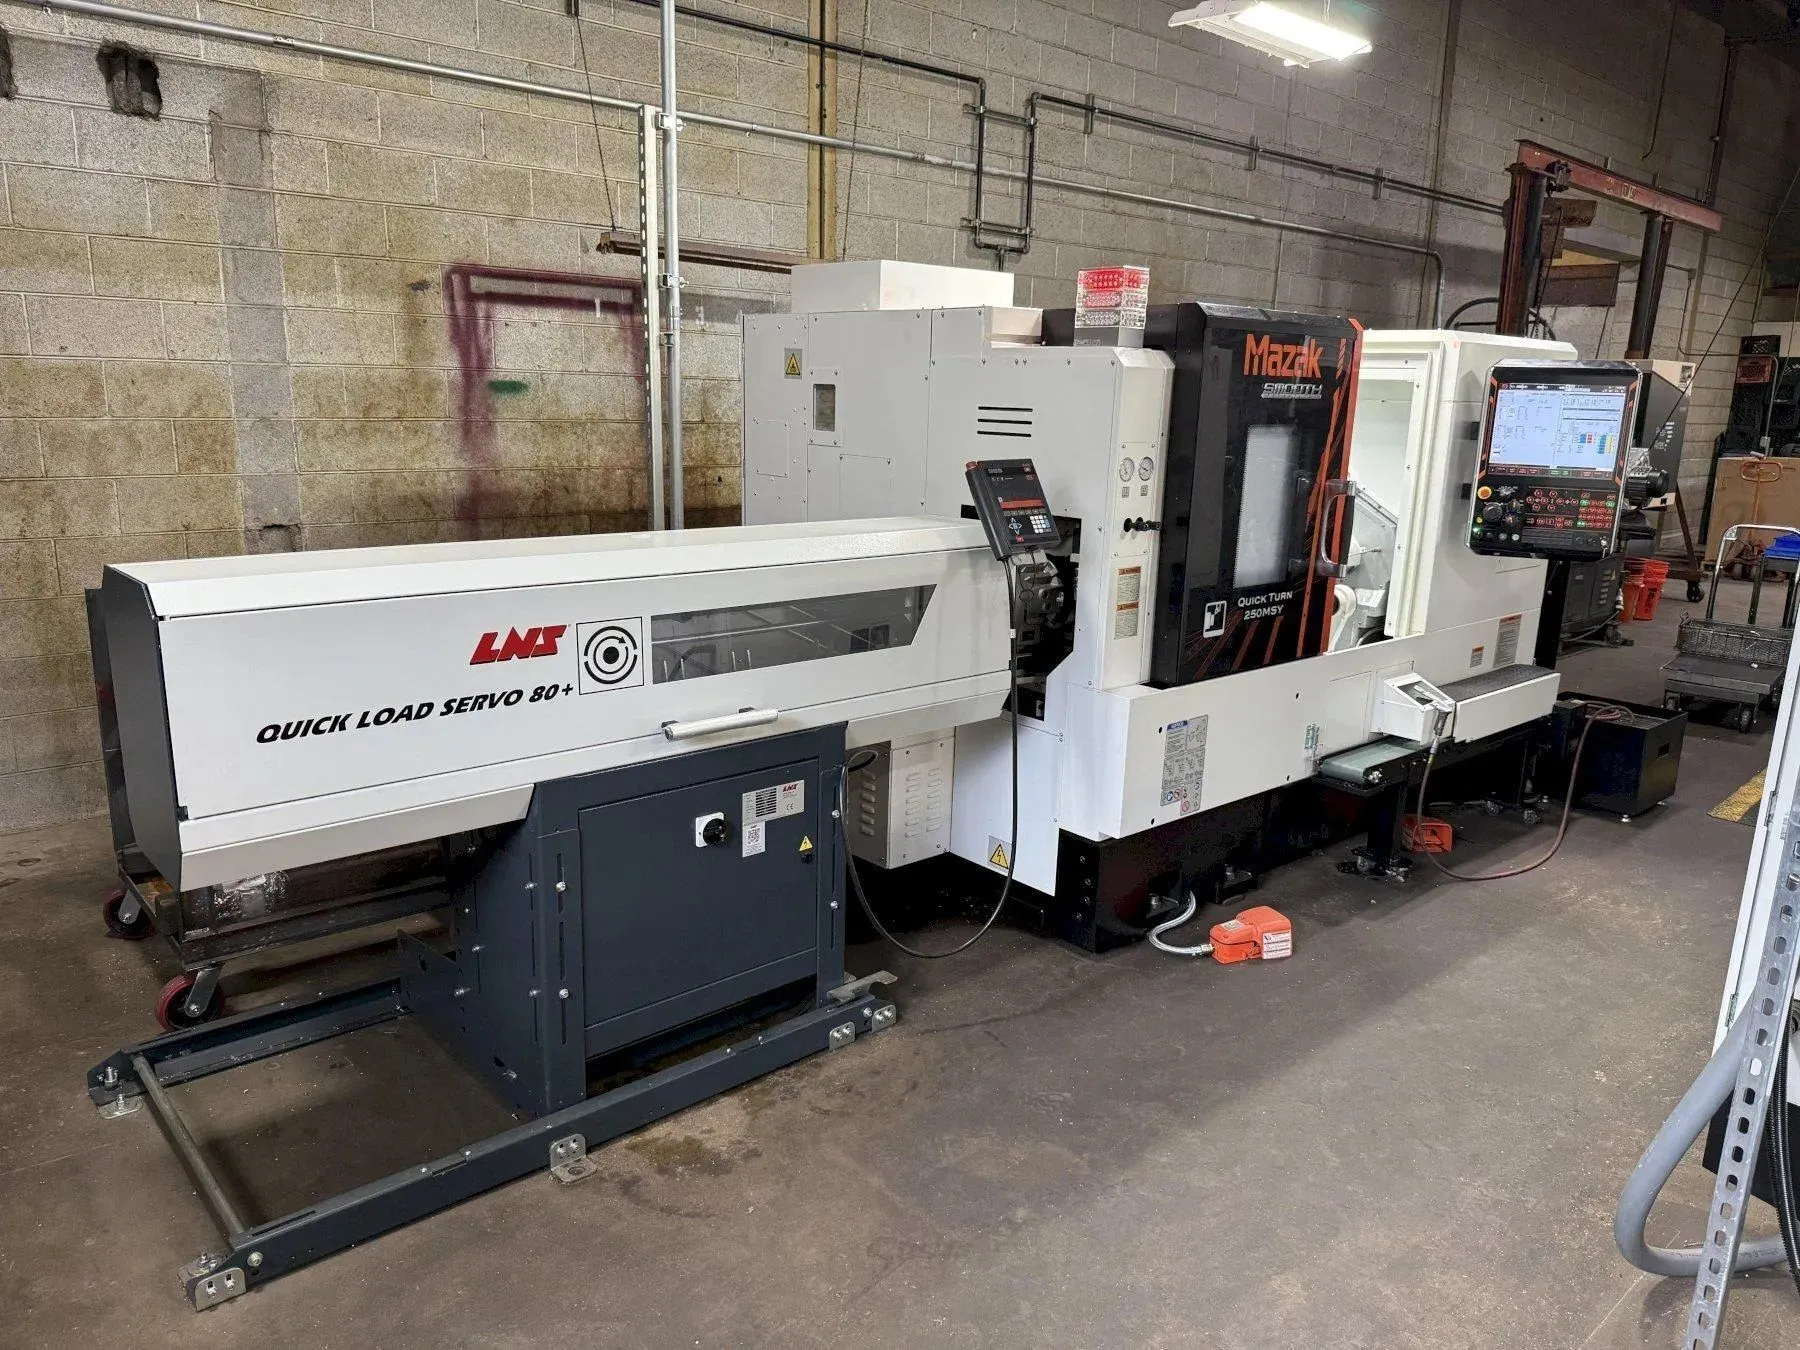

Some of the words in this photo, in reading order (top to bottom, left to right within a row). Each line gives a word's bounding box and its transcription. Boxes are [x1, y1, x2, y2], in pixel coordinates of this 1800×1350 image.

[1243, 333, 1323, 378] Mazak
[1262, 383, 1322, 394] SMOOTH
[1237, 594, 1267, 607] QUICK
[1268, 591, 1293, 602] TURN
[1243, 605, 1284, 620] 250MSY
[469, 624, 567, 665] LNS
[256, 712, 353, 744] QUICK
[355, 702, 435, 729] LOAD
[439, 689, 523, 717] SERVO
[528, 683, 574, 703] 80+
